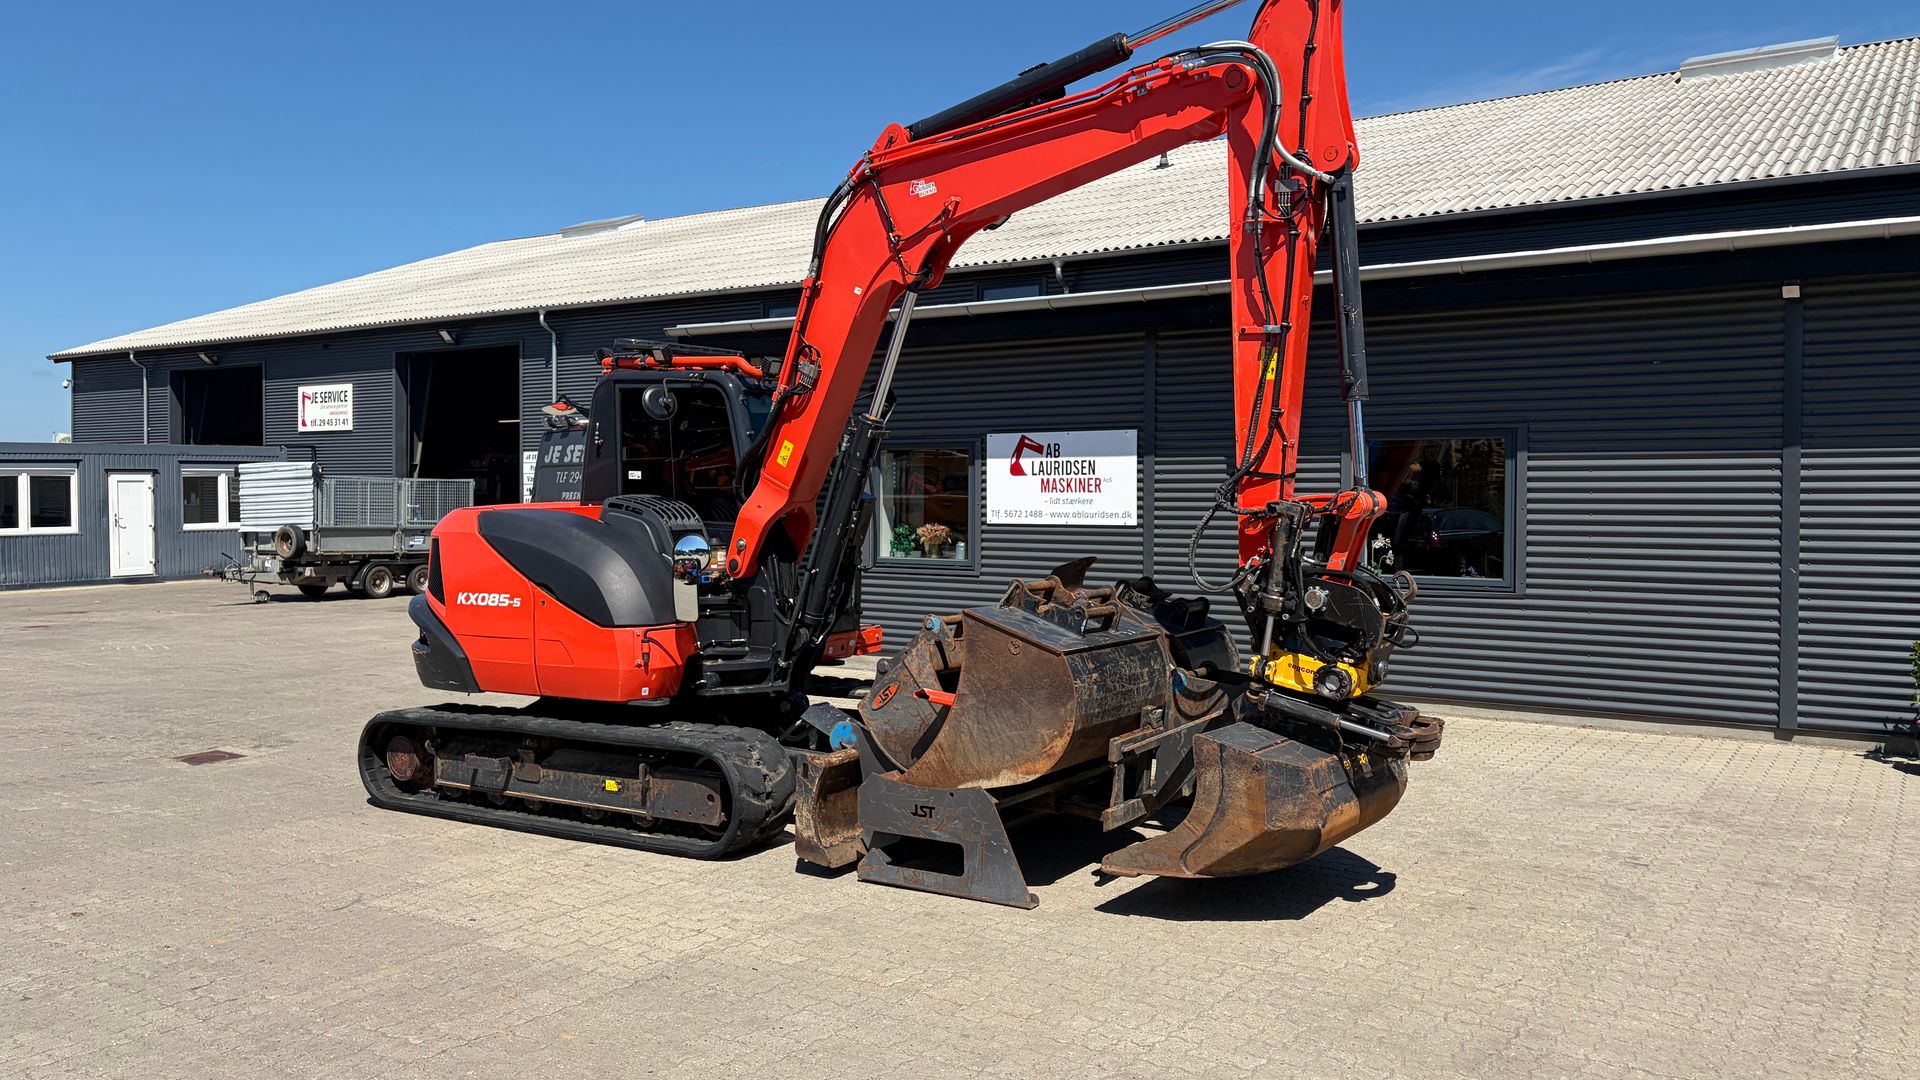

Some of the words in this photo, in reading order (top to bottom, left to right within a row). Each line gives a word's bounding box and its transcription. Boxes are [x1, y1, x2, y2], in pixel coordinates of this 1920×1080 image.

[311, 392, 318, 404] JE
[320, 390, 348, 403] SERVICE
[319, 419, 326, 427] 29
[327, 419, 333, 427] 45
[342, 418, 349, 426] 41
[545, 446, 562, 463] JE
[1045, 443, 1061, 458] AB
[1031, 460, 1096, 476] LAURIDSEN
[556, 471, 568, 483] TLF
[1040, 477, 1102, 493] MASKINER
[991, 510, 1002, 519] Tlf.
[1004, 510, 1023, 519] 5672
[1024, 510, 1043, 519] 1488
[1049, 510, 1132, 519] www.ablauridsen.dk
[911, 804, 935, 819] JST
